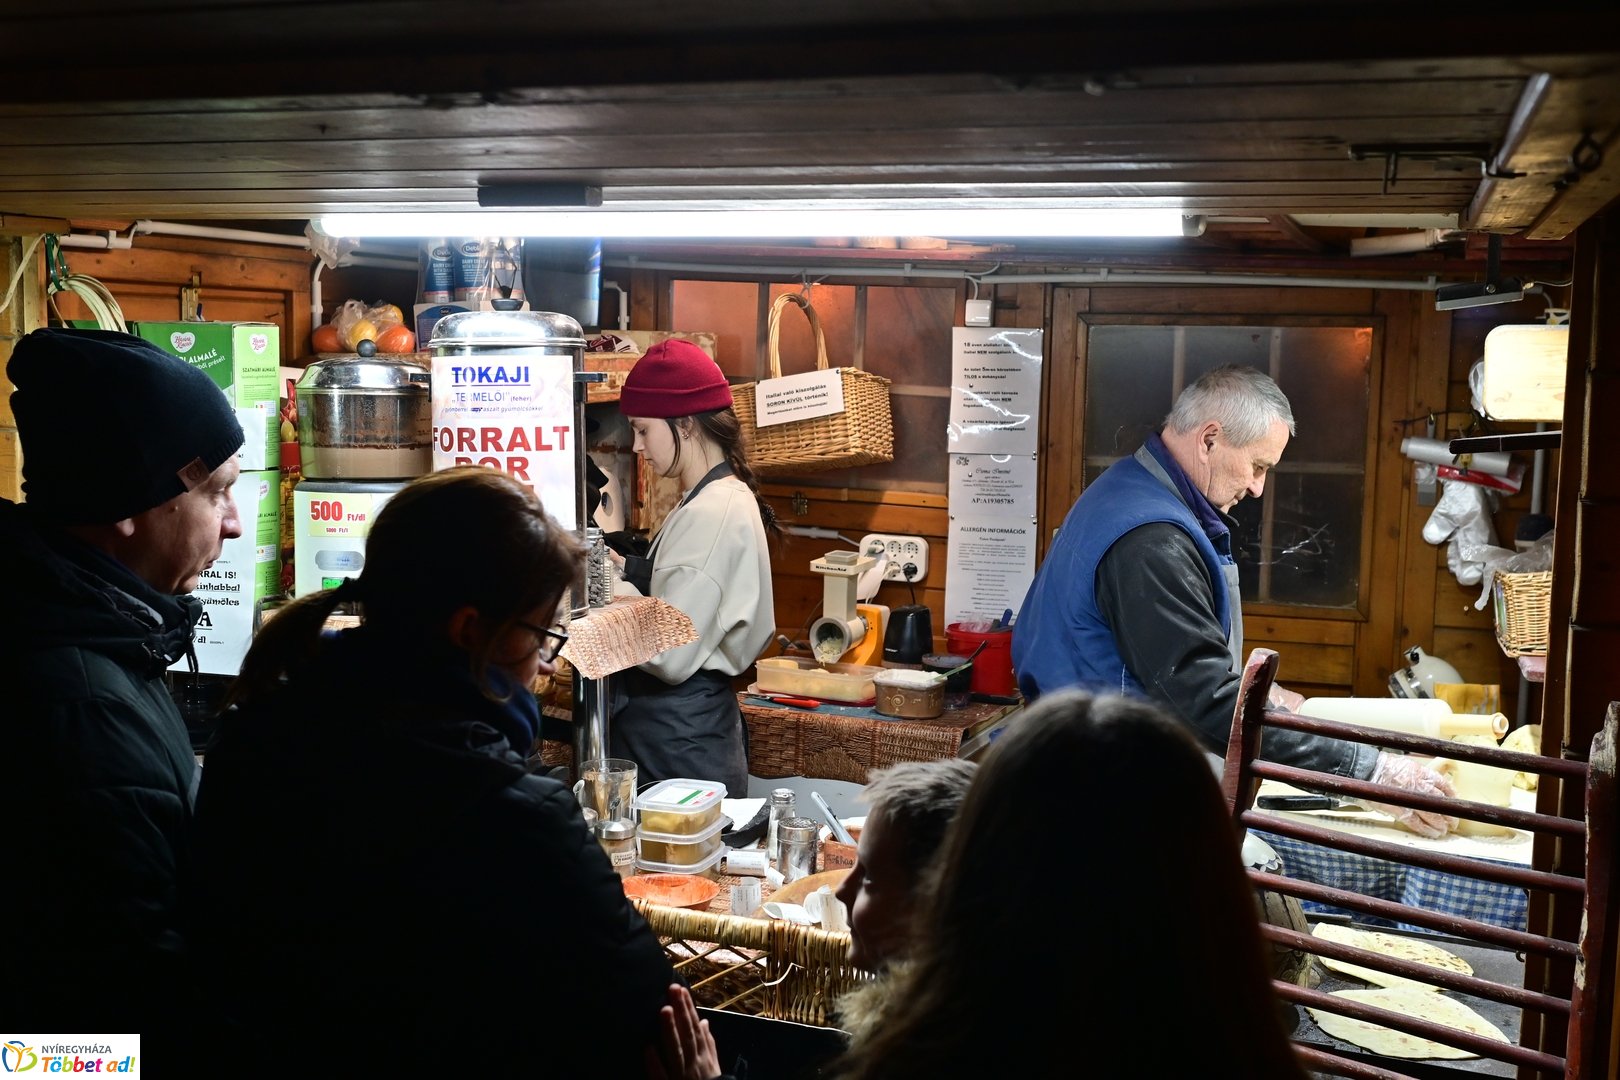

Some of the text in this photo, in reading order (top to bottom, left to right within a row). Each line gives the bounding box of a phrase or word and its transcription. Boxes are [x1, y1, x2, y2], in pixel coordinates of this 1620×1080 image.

[188, 349, 217, 364] ALMALÉ
[452, 366, 529, 383] TOKAJI
[796, 385, 826, 393] kiszolgálás
[433, 426, 569, 452] FORRALT
[310, 501, 343, 521] 500
[196, 597, 240, 606] yümölcs
